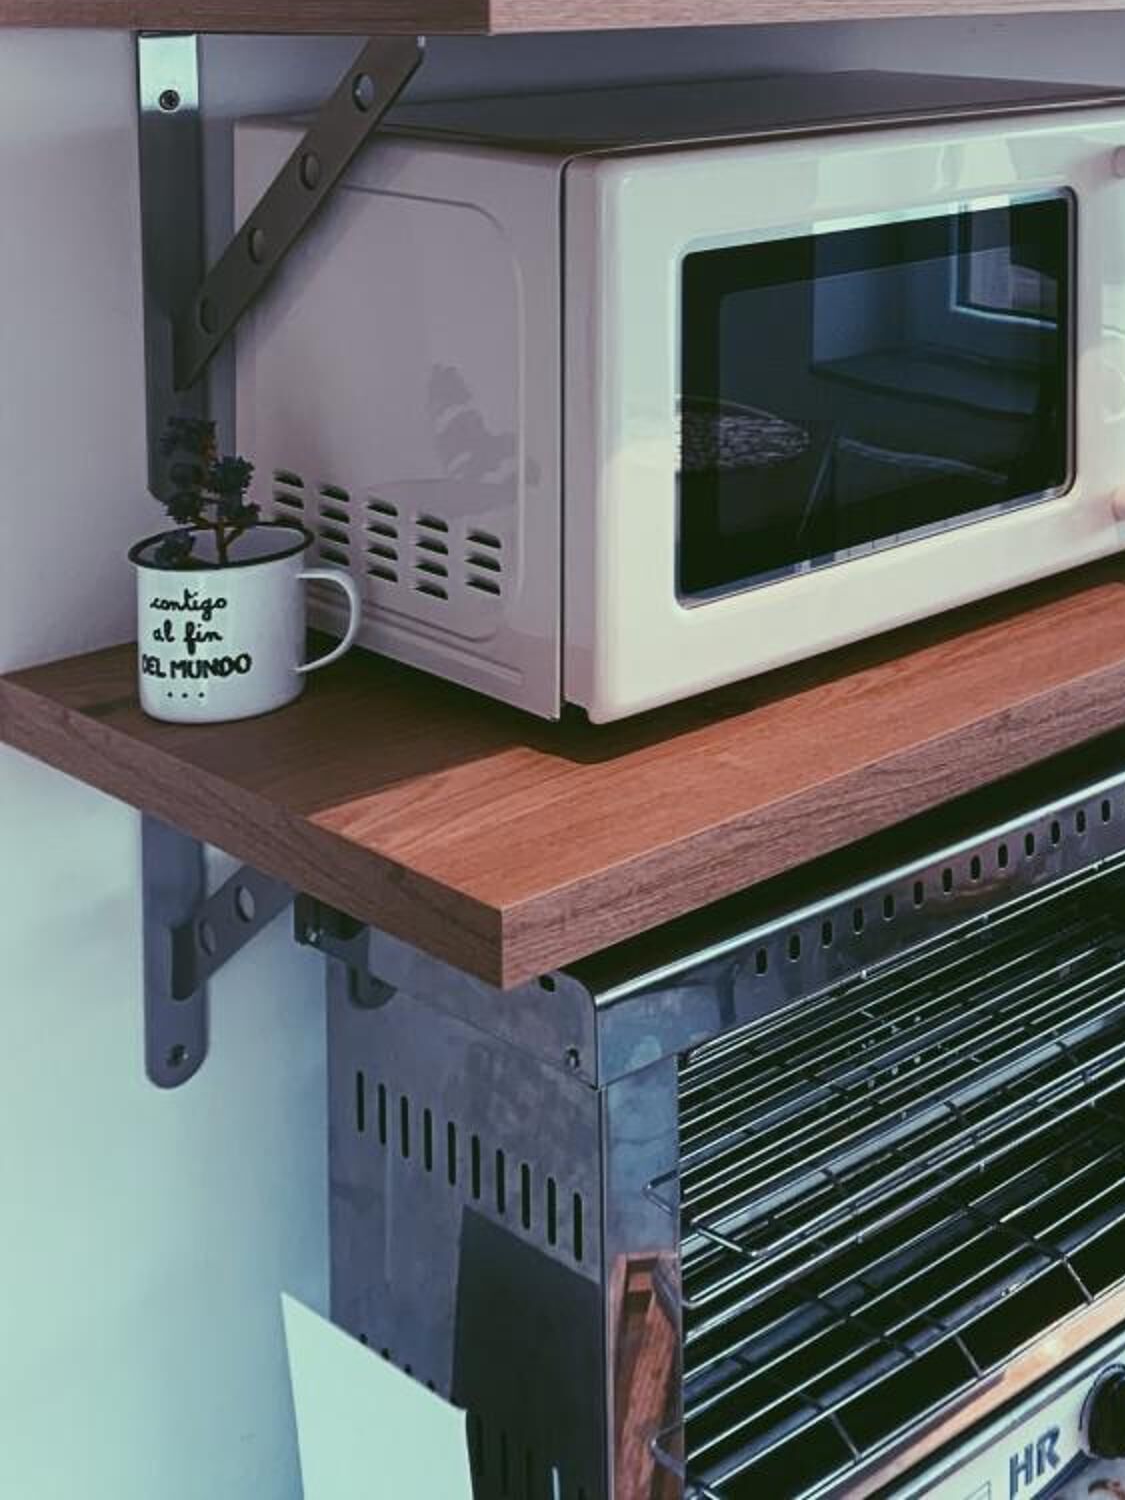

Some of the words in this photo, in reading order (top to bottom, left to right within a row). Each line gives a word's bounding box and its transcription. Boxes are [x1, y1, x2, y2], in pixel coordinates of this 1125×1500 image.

[149, 588, 228, 621] contigo
[152, 619, 175, 643] al
[184, 620, 223, 656] fin
[141, 654, 166, 679] DEL
[170, 652, 252, 680] MUNDO
[1009, 1426, 1060, 1500] HR
